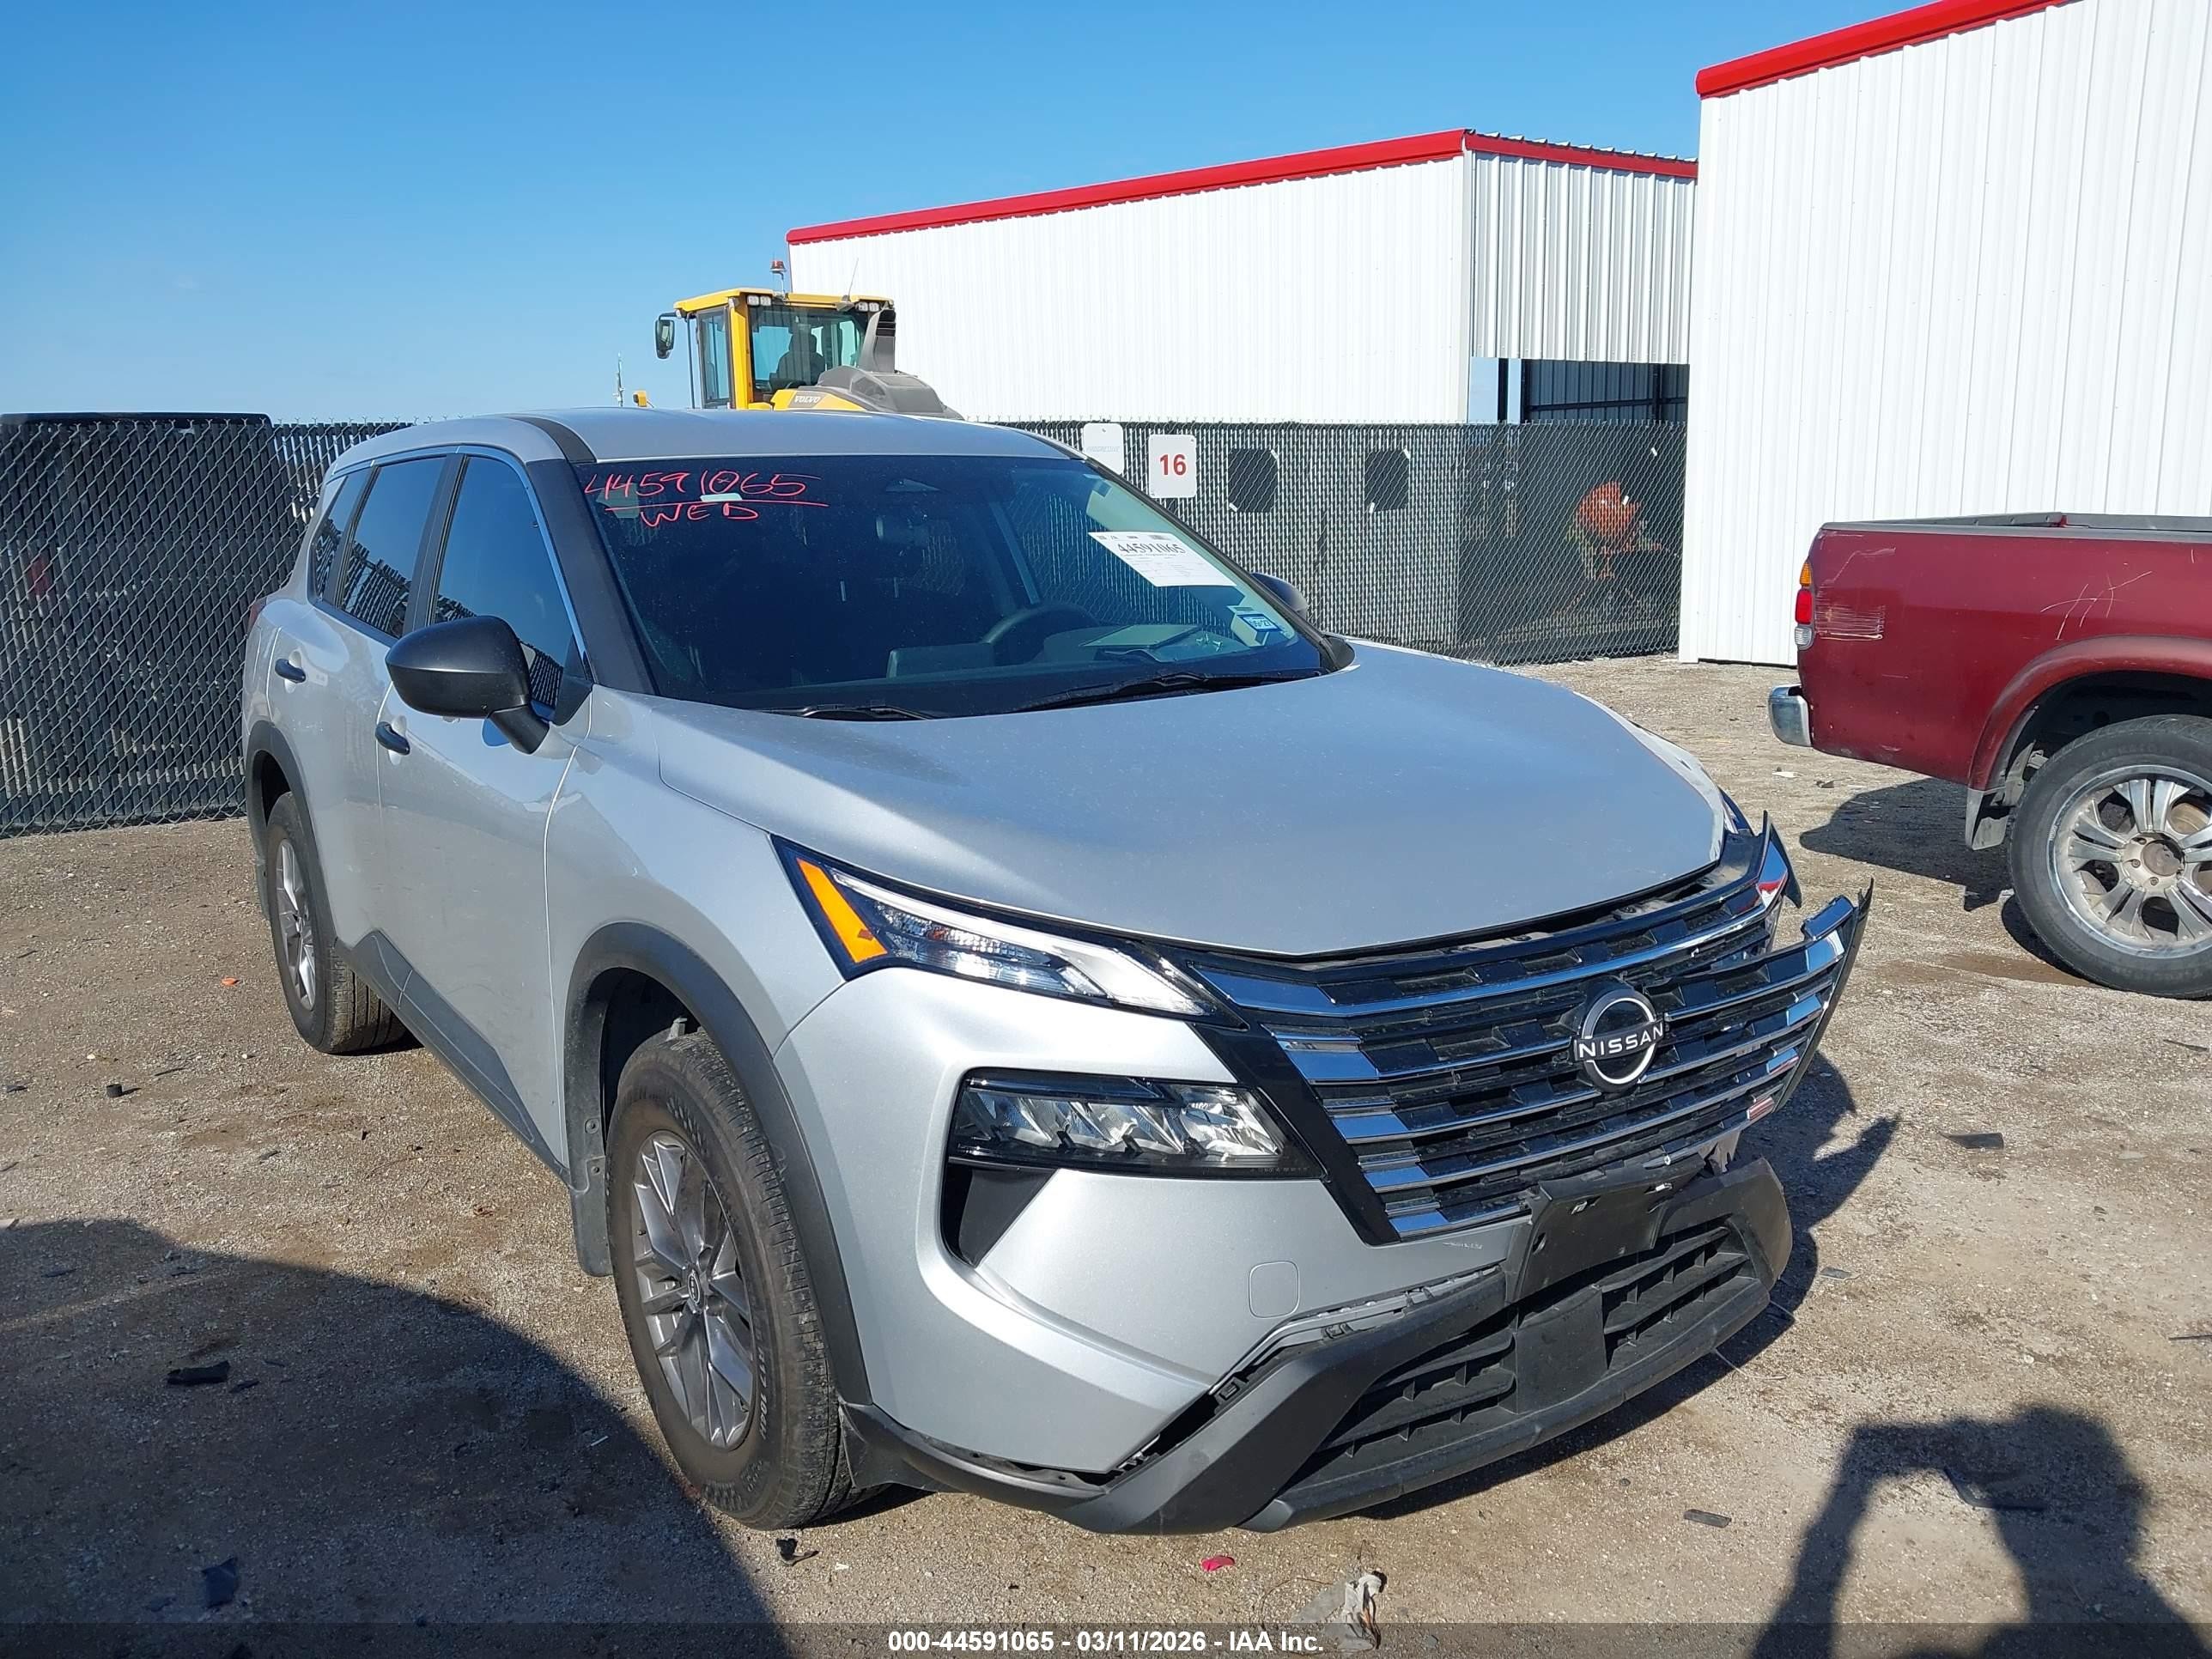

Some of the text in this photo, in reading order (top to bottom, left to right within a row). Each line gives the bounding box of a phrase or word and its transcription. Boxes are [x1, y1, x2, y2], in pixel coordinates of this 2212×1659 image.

[793, 395, 821, 404] VOLVO
[1160, 454, 1187, 475] 16
[585, 470, 823, 500] 44591065
[641, 503, 759, 527] WED
[1117, 543, 1187, 554] 44591065
[1578, 1023, 1664, 1058] NISSAN
